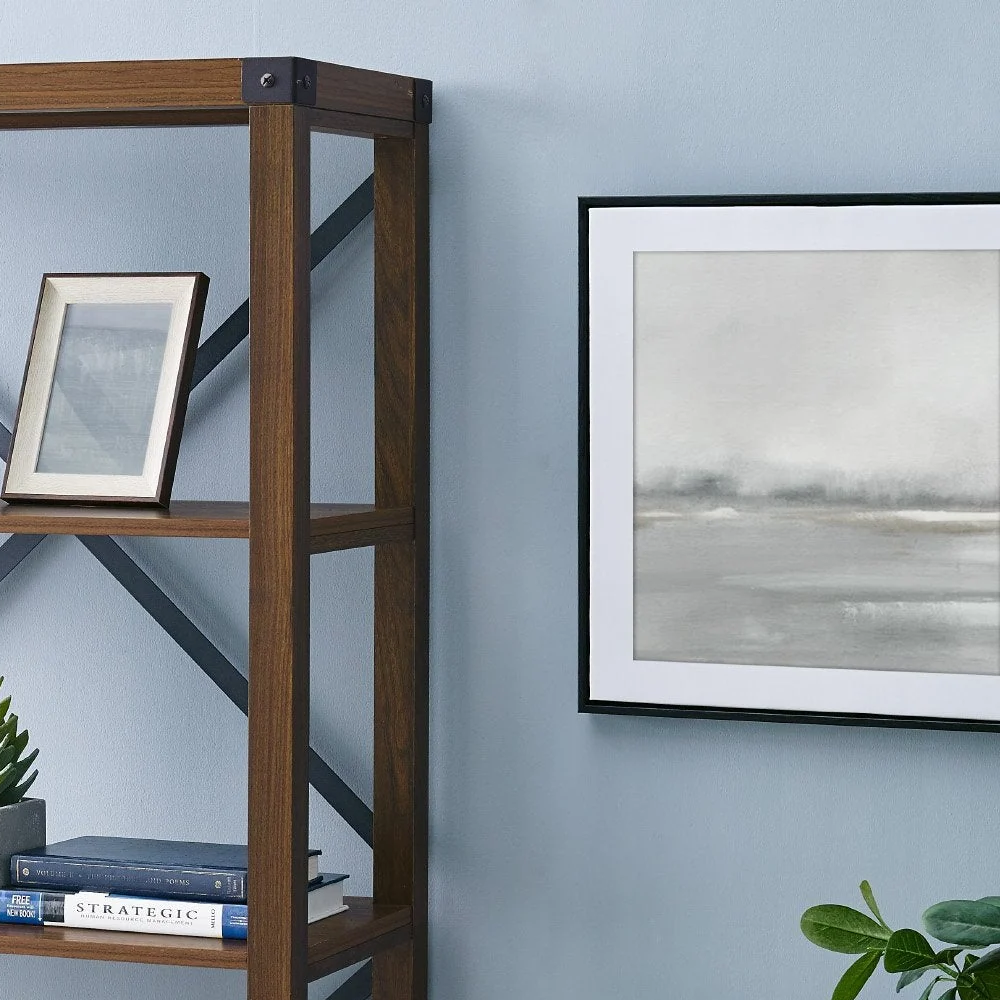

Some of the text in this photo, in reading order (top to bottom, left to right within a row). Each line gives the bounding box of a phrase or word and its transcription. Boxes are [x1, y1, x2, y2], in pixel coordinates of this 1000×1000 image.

[11, 894, 30, 904] FREE
[6, 908, 17, 916] NEW
[76, 902, 198, 920] STRATEGIC
